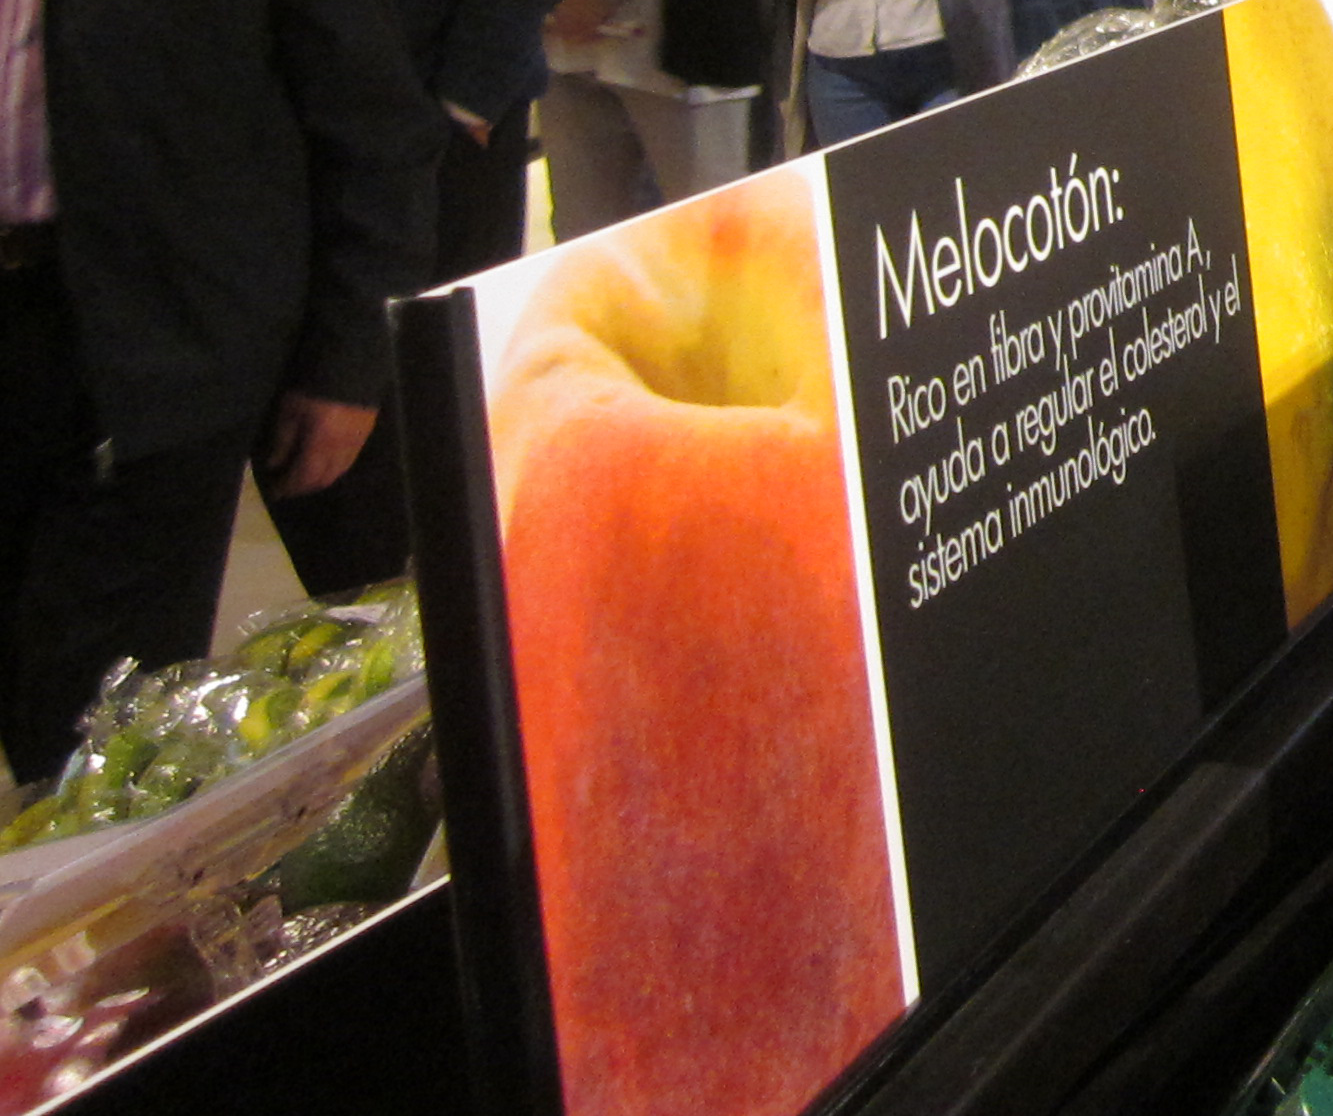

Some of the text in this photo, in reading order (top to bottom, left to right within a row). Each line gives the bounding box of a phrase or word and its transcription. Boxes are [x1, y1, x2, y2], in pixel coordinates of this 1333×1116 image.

[875, 152, 1124, 340] Melocotón:
[886, 216, 1212, 444] Rico en fibra y provitamina A,
[899, 253, 1242, 536] ayuda a regular el colesterol y el
[907, 407, 1158, 610] sistema inmunológico.
